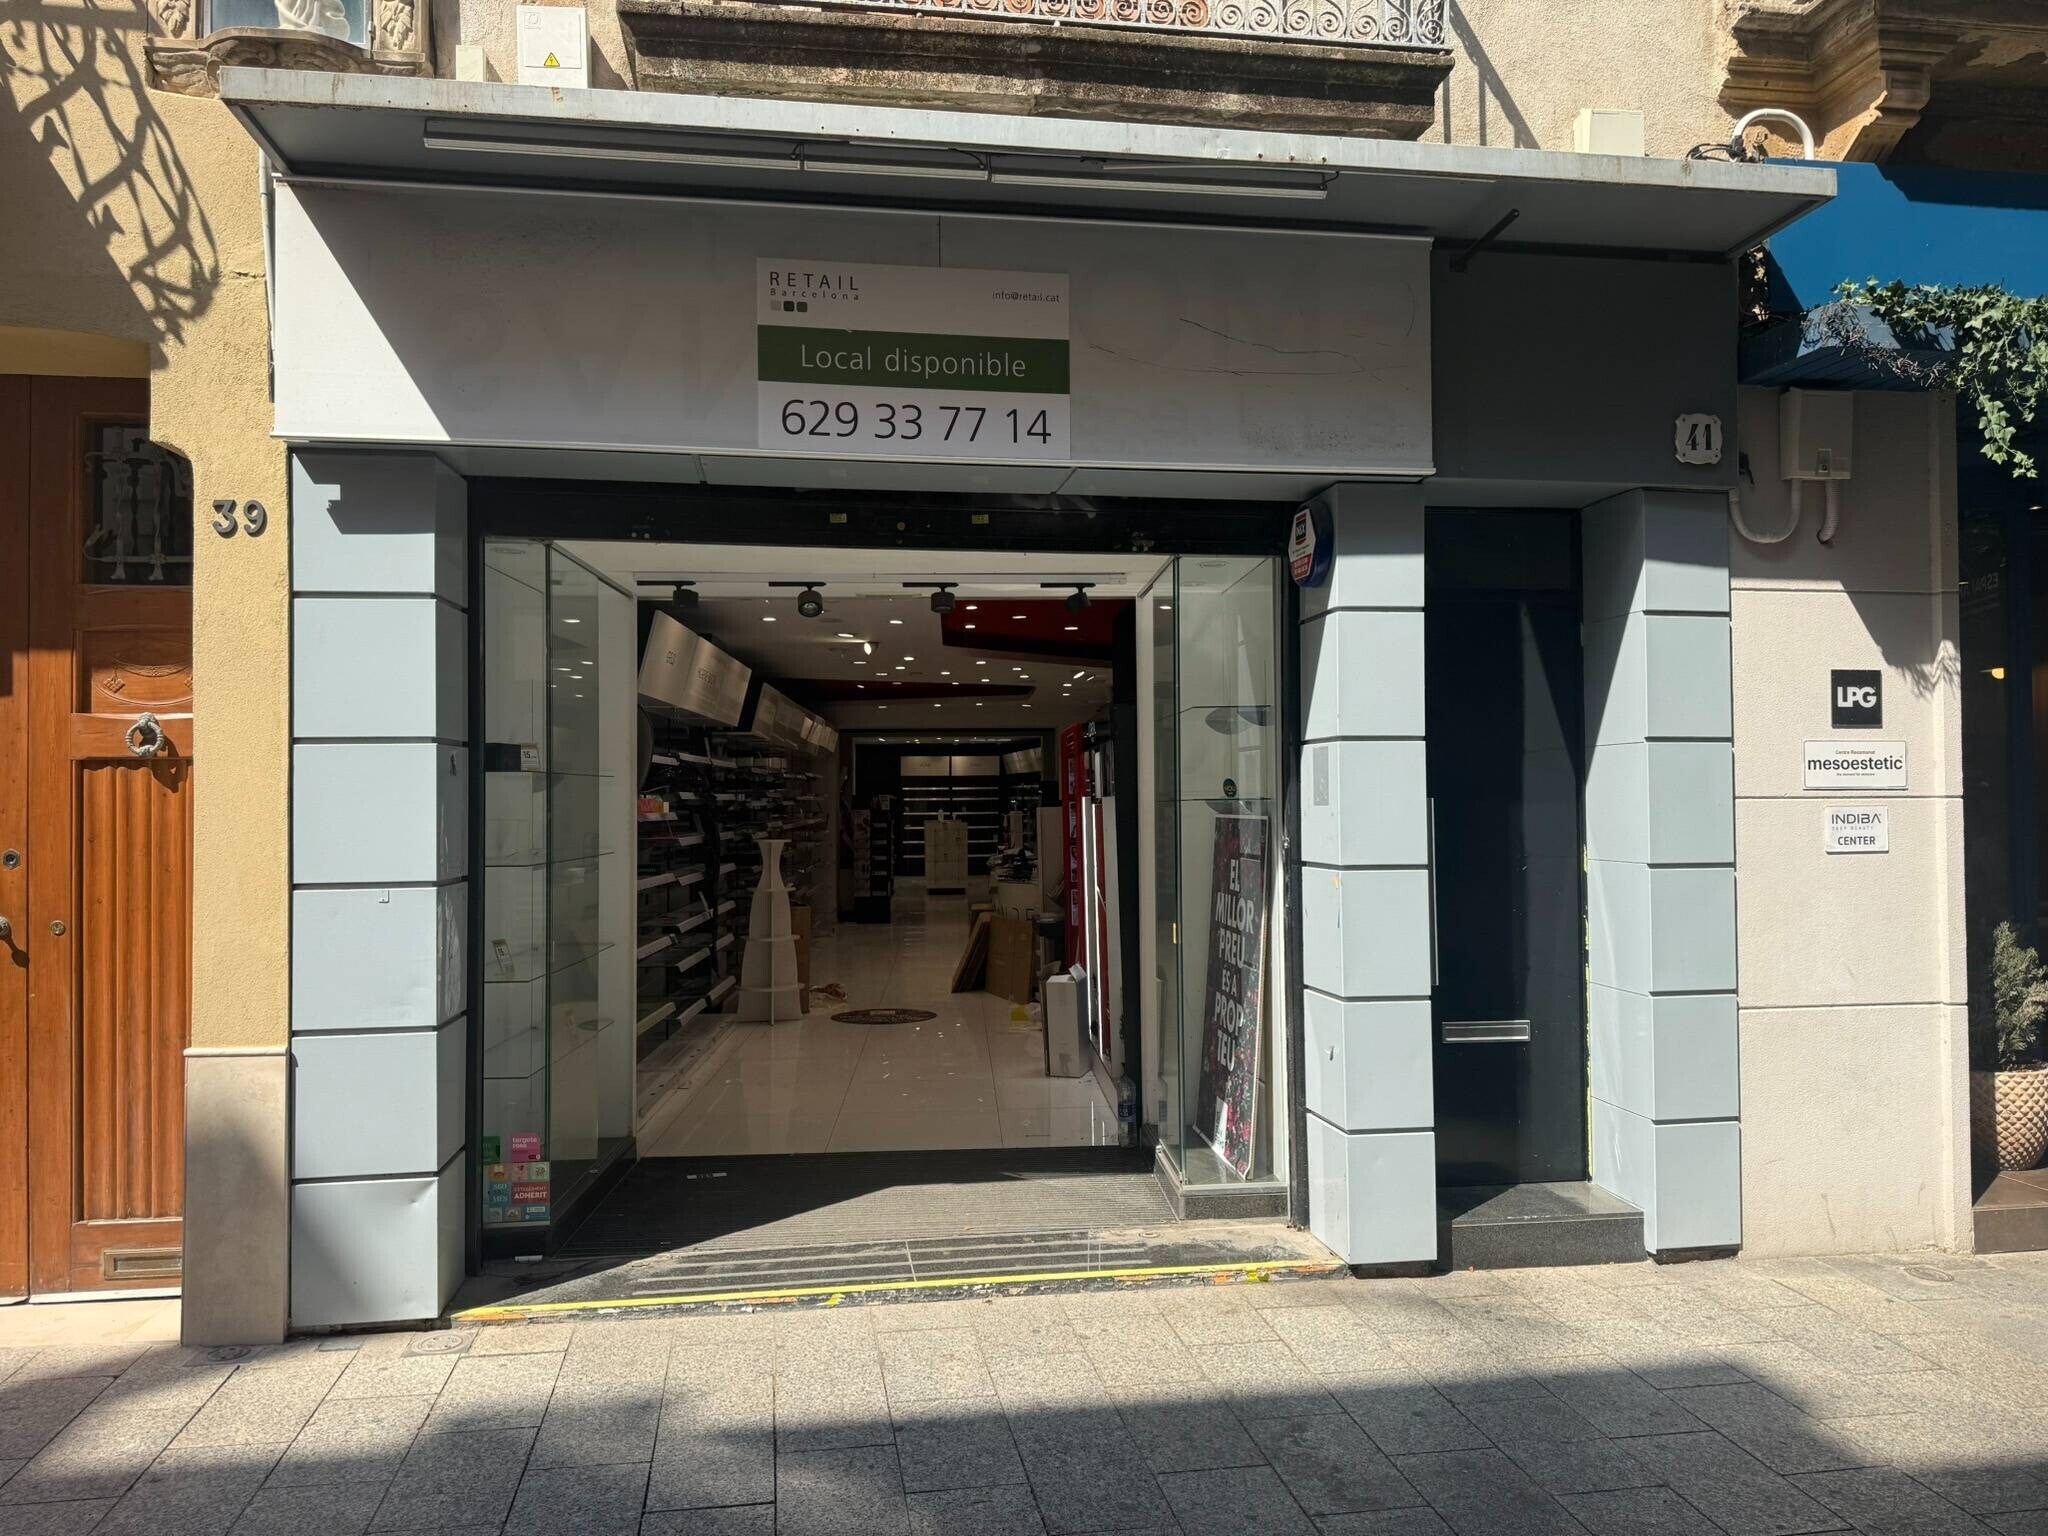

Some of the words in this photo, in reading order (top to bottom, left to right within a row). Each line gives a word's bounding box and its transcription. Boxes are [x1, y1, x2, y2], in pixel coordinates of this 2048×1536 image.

[769, 271, 859, 291] RETAIL
[770, 289, 860, 301] Barcelona
[992, 290, 1060, 303] info@retail.cat
[801, 344, 871, 371] Local
[885, 348, 1026, 379] disponible
[781, 399, 859, 438] 629
[874, 403, 923, 440] 33
[939, 406, 987, 442] 77
[1005, 408, 1052, 445] 14
[1685, 423, 1712, 451] 41
[212, 498, 268, 538] 39
[1837, 686, 1877, 708] LPG
[1807, 755, 1903, 771] mesoestetic
[1831, 813, 1881, 825] INDIBA
[1837, 836, 1876, 845] CENTER
[1229, 859, 1240, 892] EL
[1215, 892, 1255, 934] MILLOR
[1219, 928, 1246, 969] PREU
[1214, 993, 1244, 1036] PROP
[1216, 1034, 1236, 1073] TEU
[513, 1191, 548, 1200] ADHERIT
